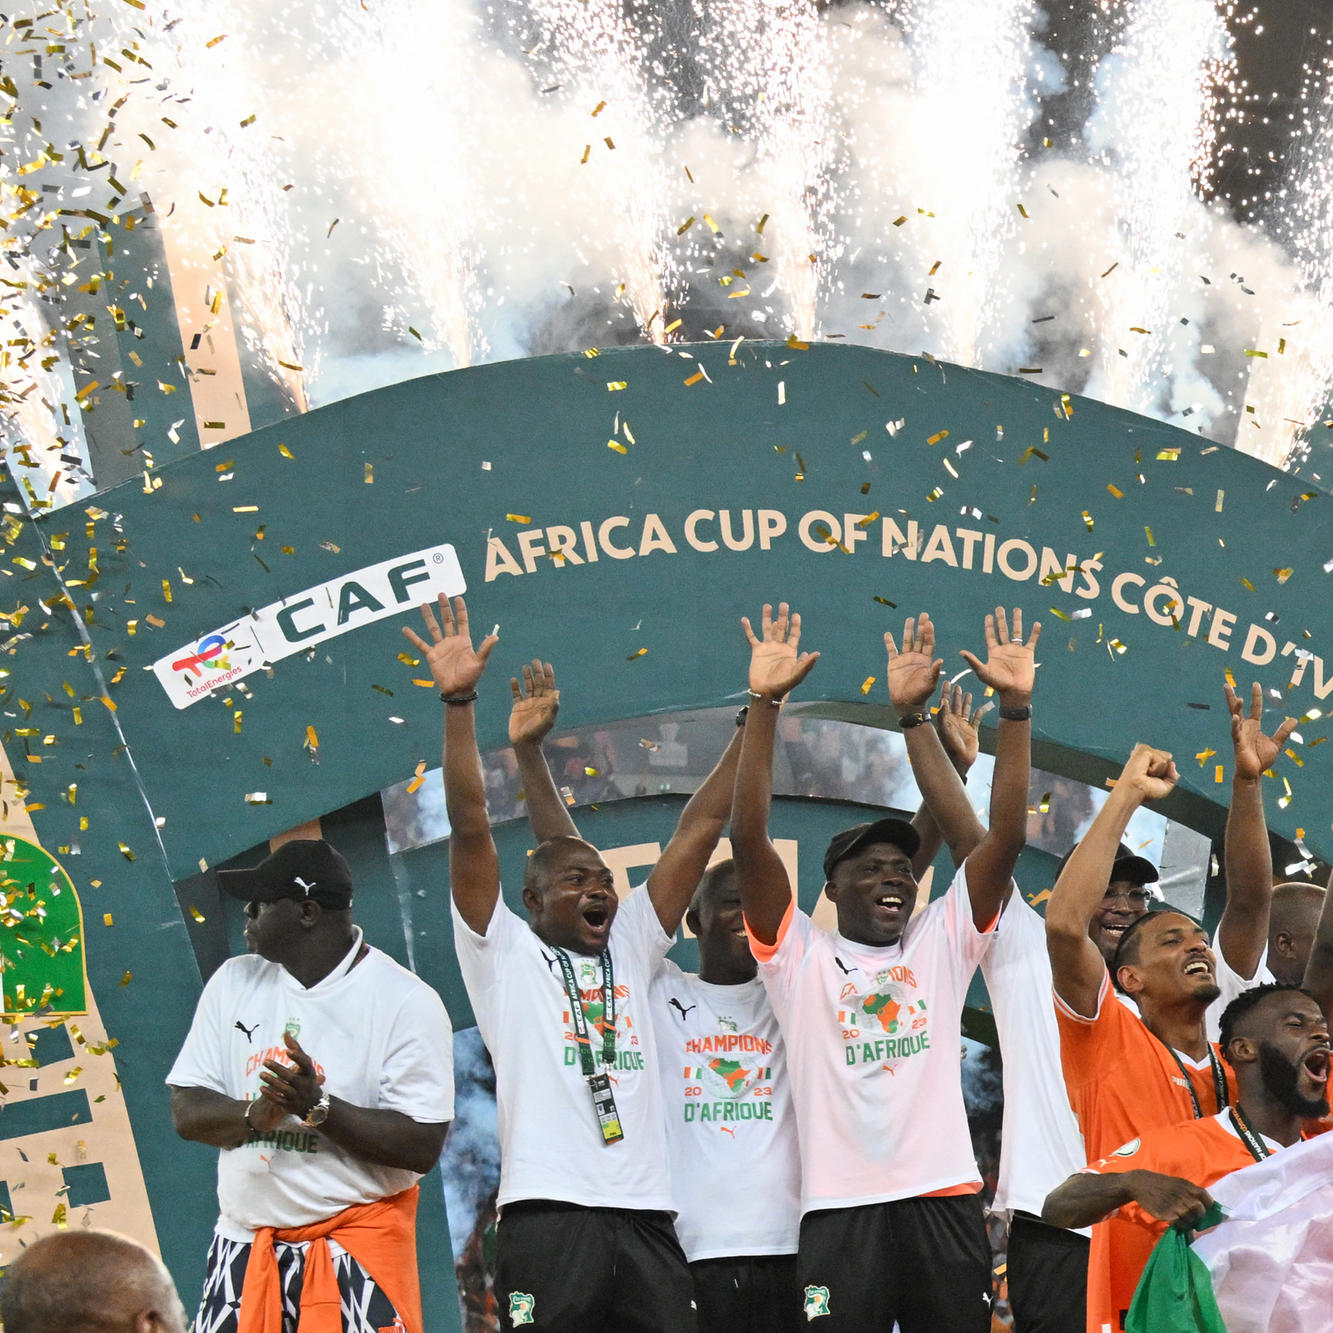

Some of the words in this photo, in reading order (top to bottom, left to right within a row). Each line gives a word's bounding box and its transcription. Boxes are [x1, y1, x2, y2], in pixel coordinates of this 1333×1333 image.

[484, 513, 677, 583] AFRICA
[684, 509, 787, 553] CUP
[798, 509, 870, 554] OF
[882, 516, 1103, 600] NATIONS
[1111, 572, 1238, 651] CÔTE
[276, 558, 431, 643] CAF
[186, 665, 243, 699] TotalEnergies
[845, 1031, 930, 1066] D'AFRIQUE
[684, 1086, 702, 1097] 20
[753, 1087, 773, 1097] 23
[684, 1101, 773, 1122] D'AFRIQUE
